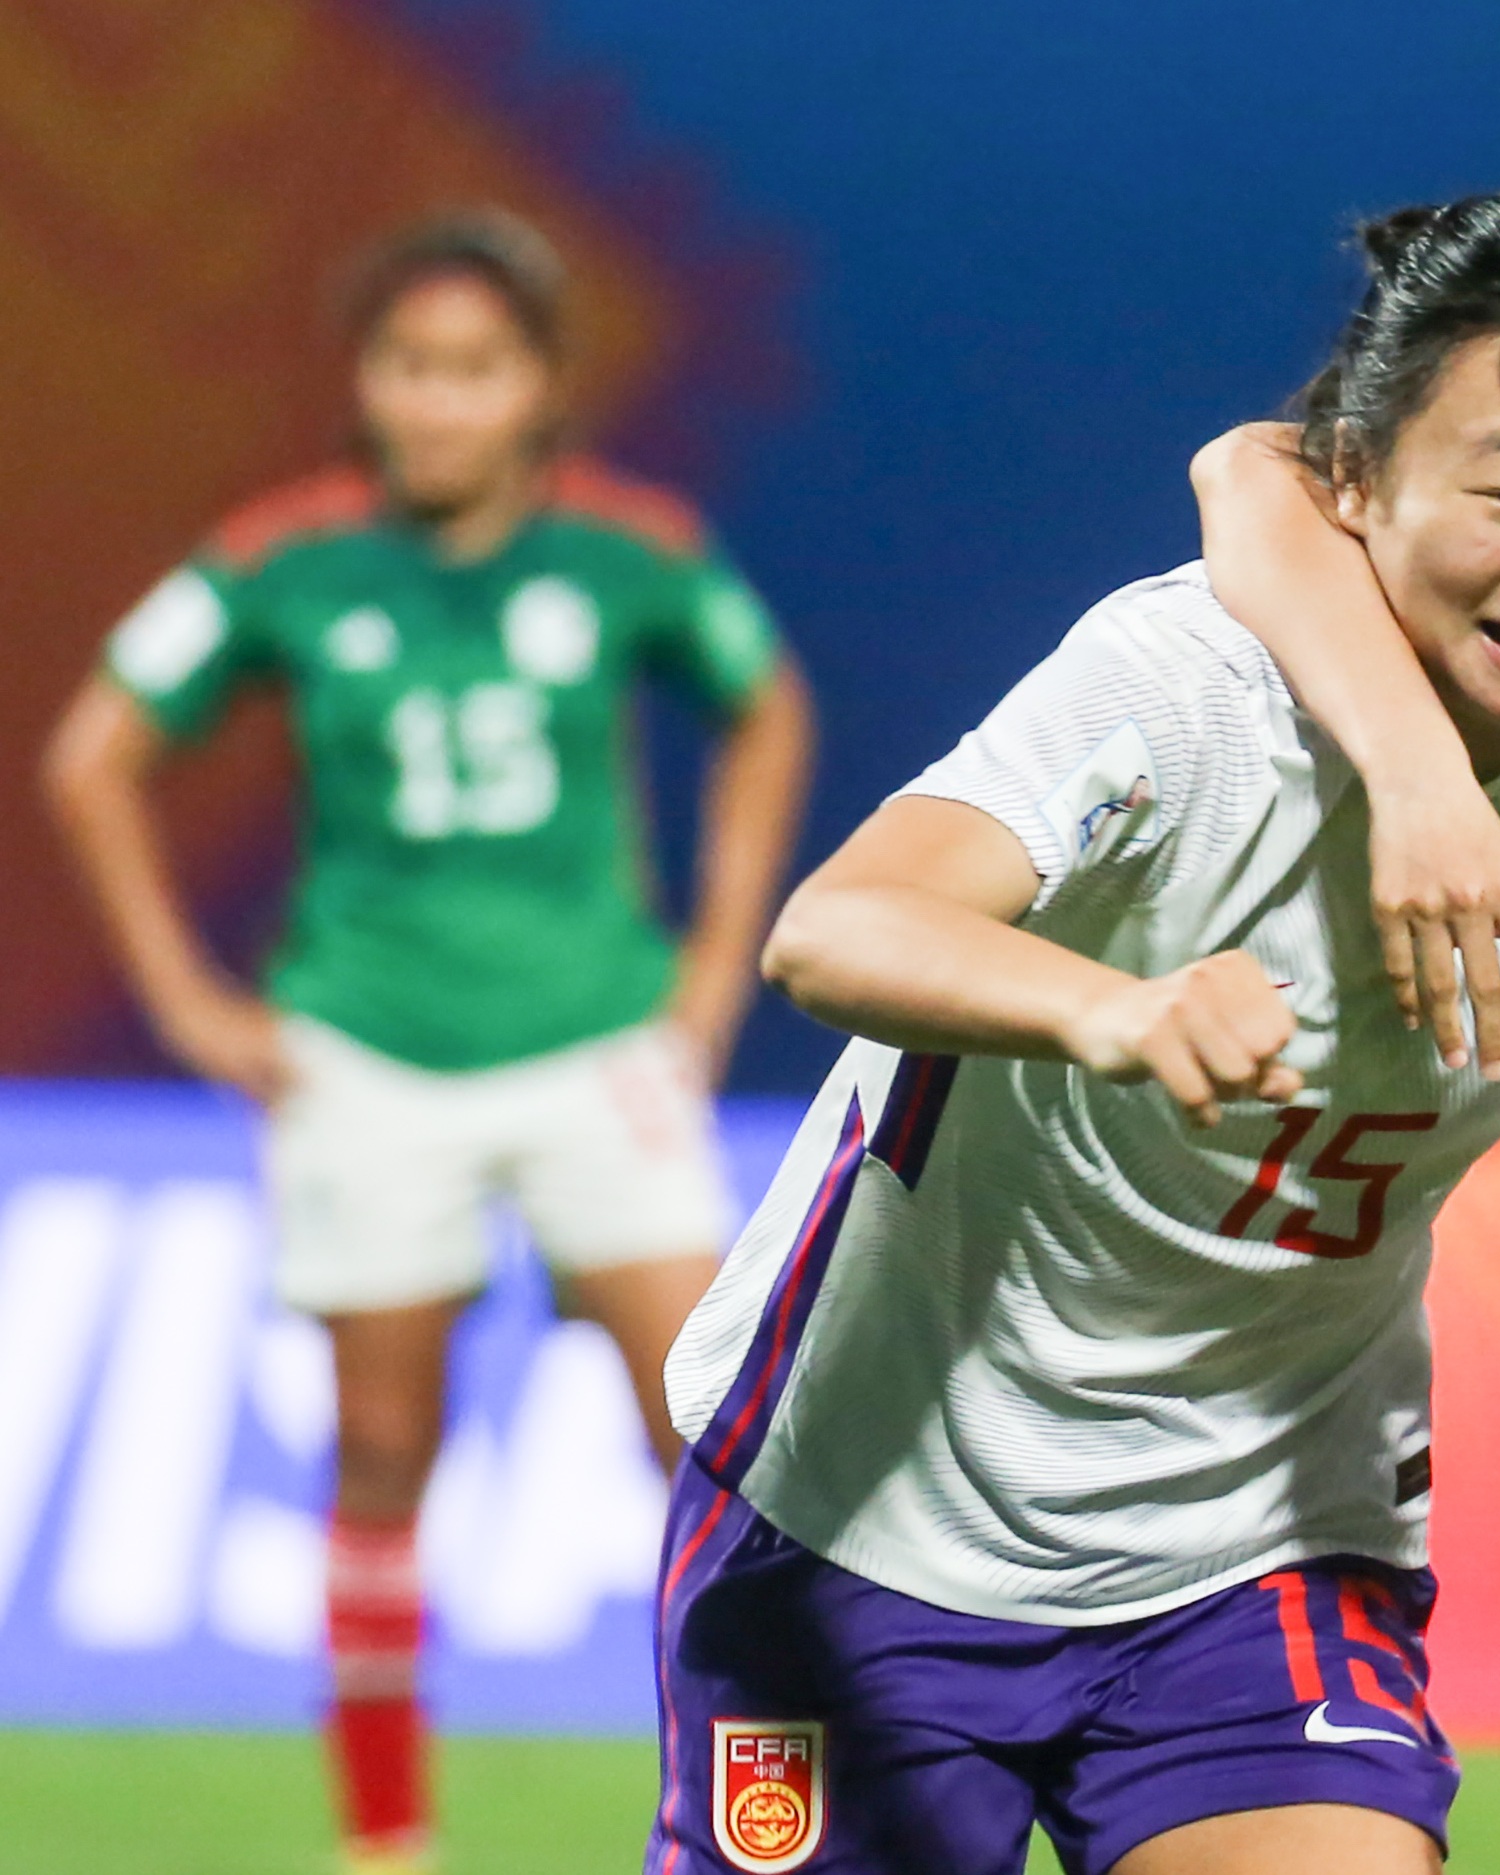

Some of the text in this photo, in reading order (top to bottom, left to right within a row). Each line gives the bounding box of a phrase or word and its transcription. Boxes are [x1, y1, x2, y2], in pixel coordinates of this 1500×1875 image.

[385, 680, 561, 840] 15
[1218, 1106, 1440, 1259] 15
[730, 1737, 808, 1763] CFA
